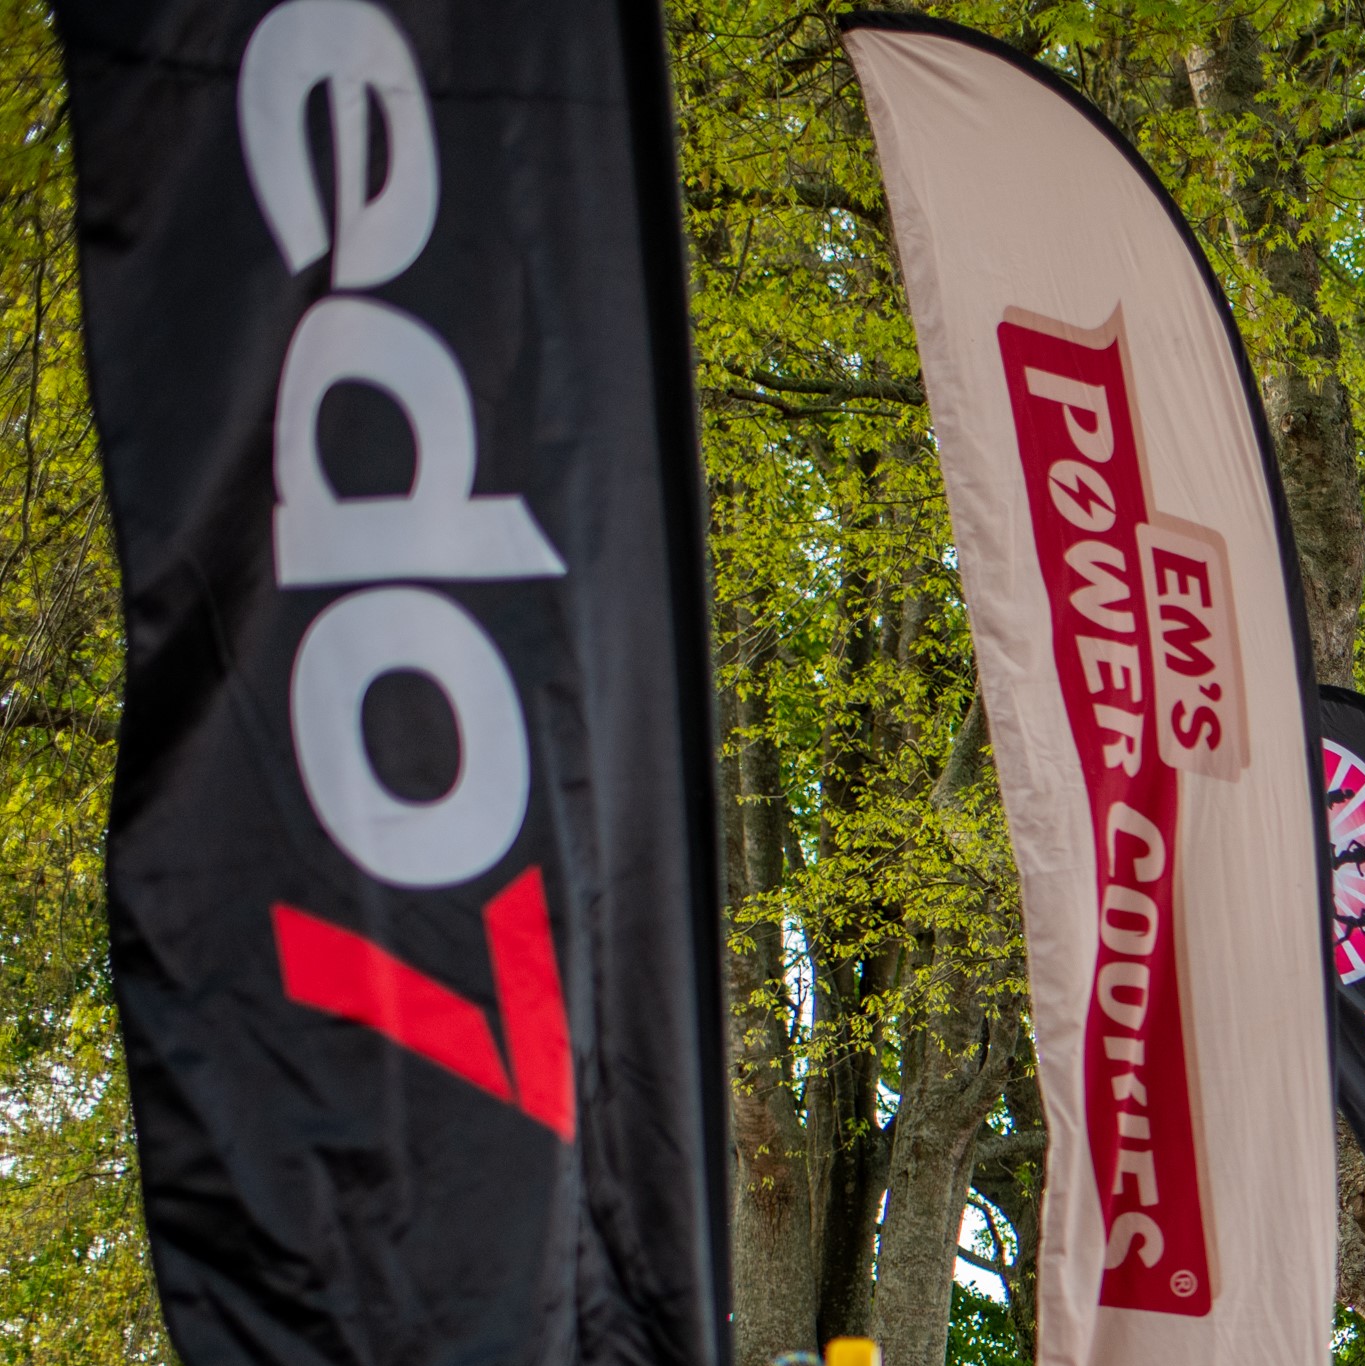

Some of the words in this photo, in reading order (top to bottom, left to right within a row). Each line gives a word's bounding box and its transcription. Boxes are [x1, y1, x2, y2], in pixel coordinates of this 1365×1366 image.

[1023, 366, 1146, 778] POWER
[1097, 801, 1166, 1270] COOKIES
[1151, 546, 1223, 752] EM'S
